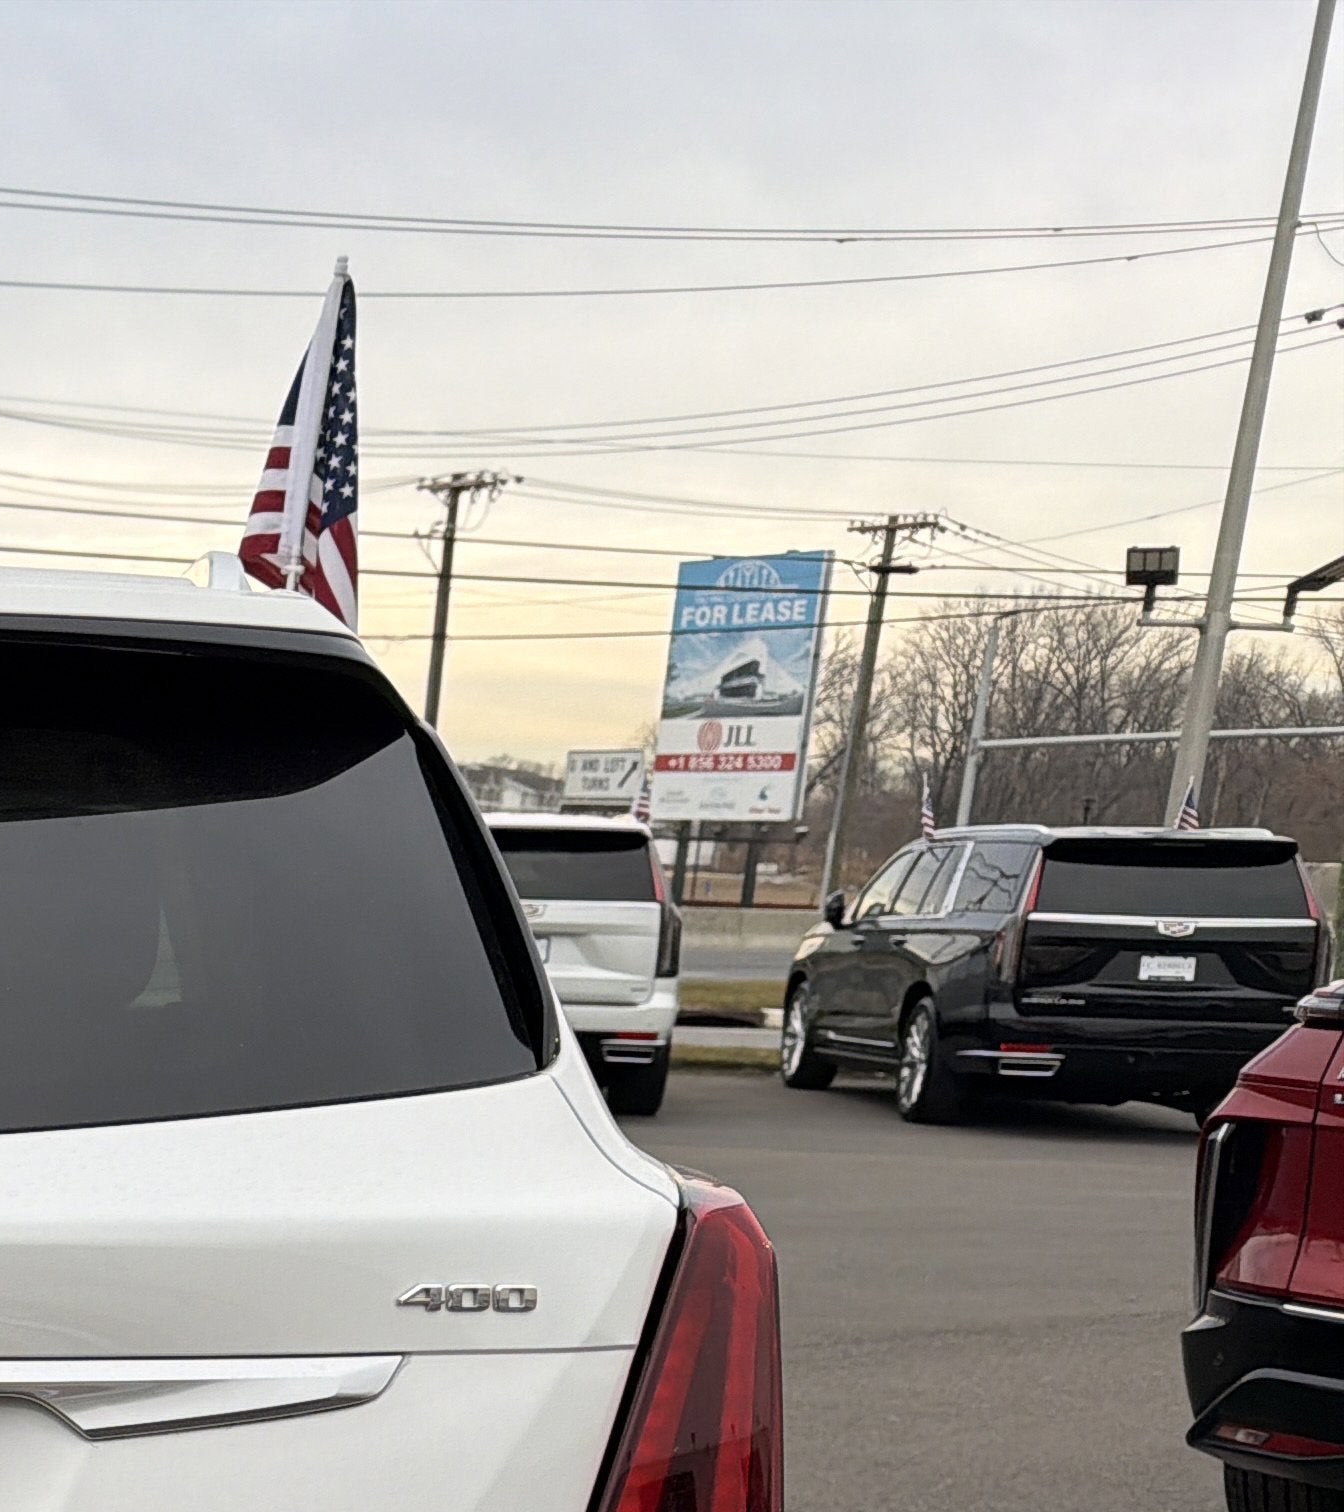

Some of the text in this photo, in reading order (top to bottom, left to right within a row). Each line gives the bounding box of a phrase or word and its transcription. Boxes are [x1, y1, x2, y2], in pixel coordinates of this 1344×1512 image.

[680, 599, 808, 628] FOR LEASE
[723, 724, 756, 748] JLL
[395, 1283, 538, 1312] 400
